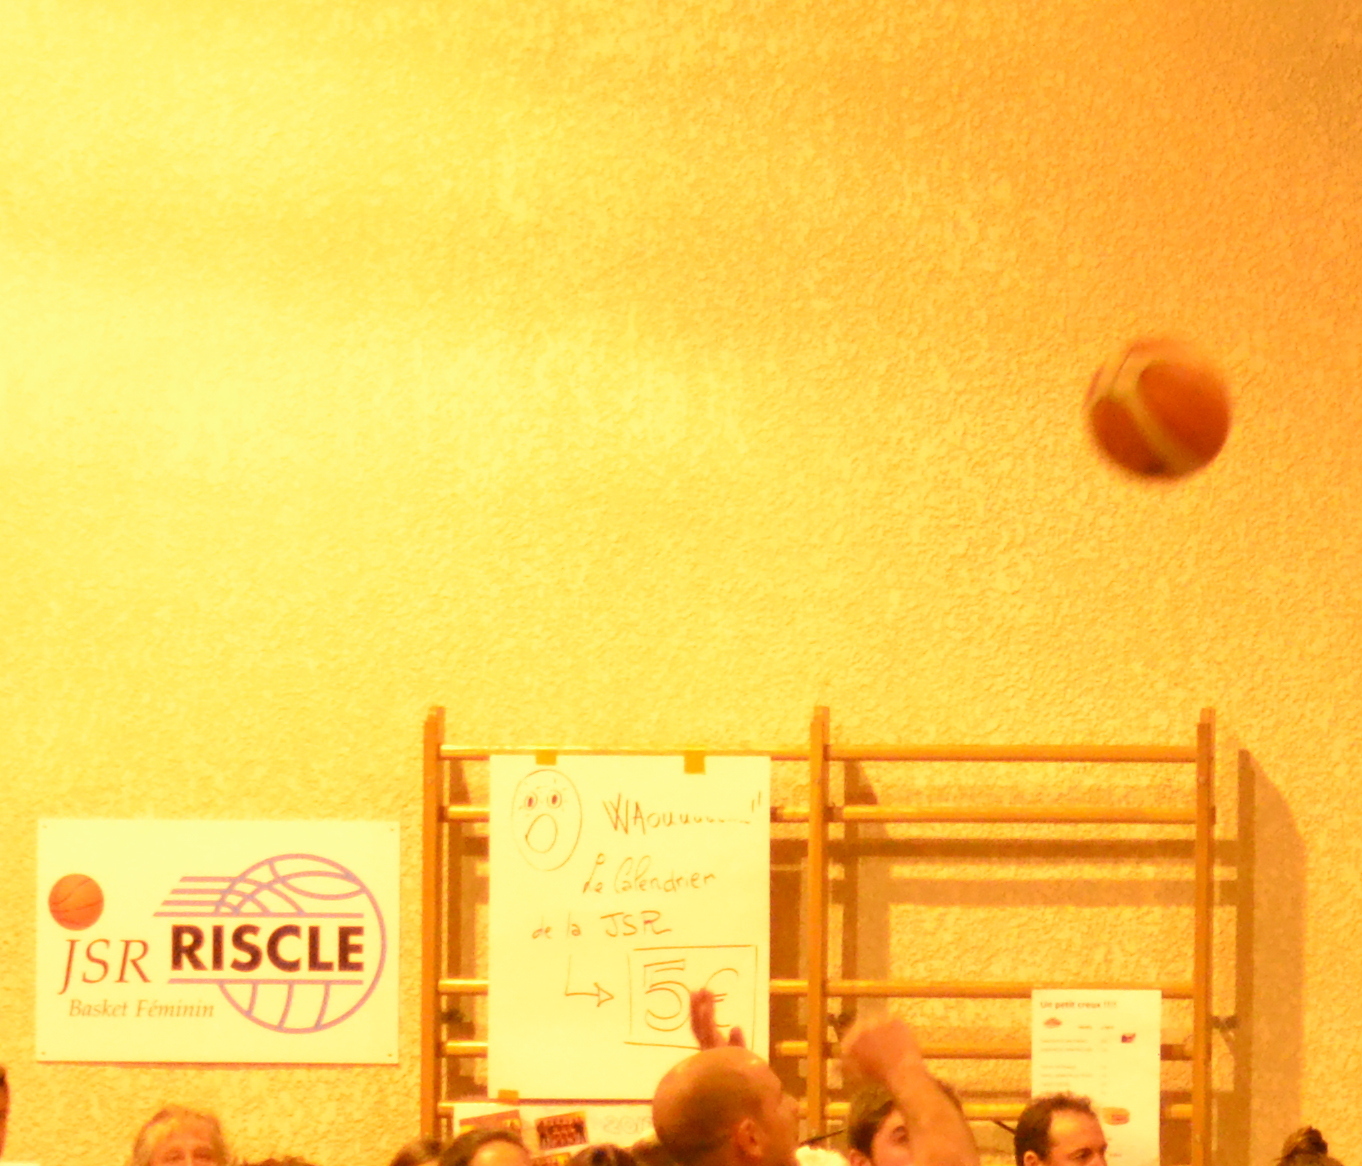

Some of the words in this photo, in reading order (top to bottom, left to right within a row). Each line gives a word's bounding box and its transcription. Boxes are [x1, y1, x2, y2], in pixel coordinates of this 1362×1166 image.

[614, 854, 717, 894] Calendrier
[531, 916, 552, 940] de
[566, 913, 581, 937] la
[600, 910, 672, 937] JSR
[57, 938, 152, 995] JSR
[170, 924, 365, 973] RISCLE
[69, 999, 128, 1018] Basket
[134, 999, 215, 1018] Féminin
